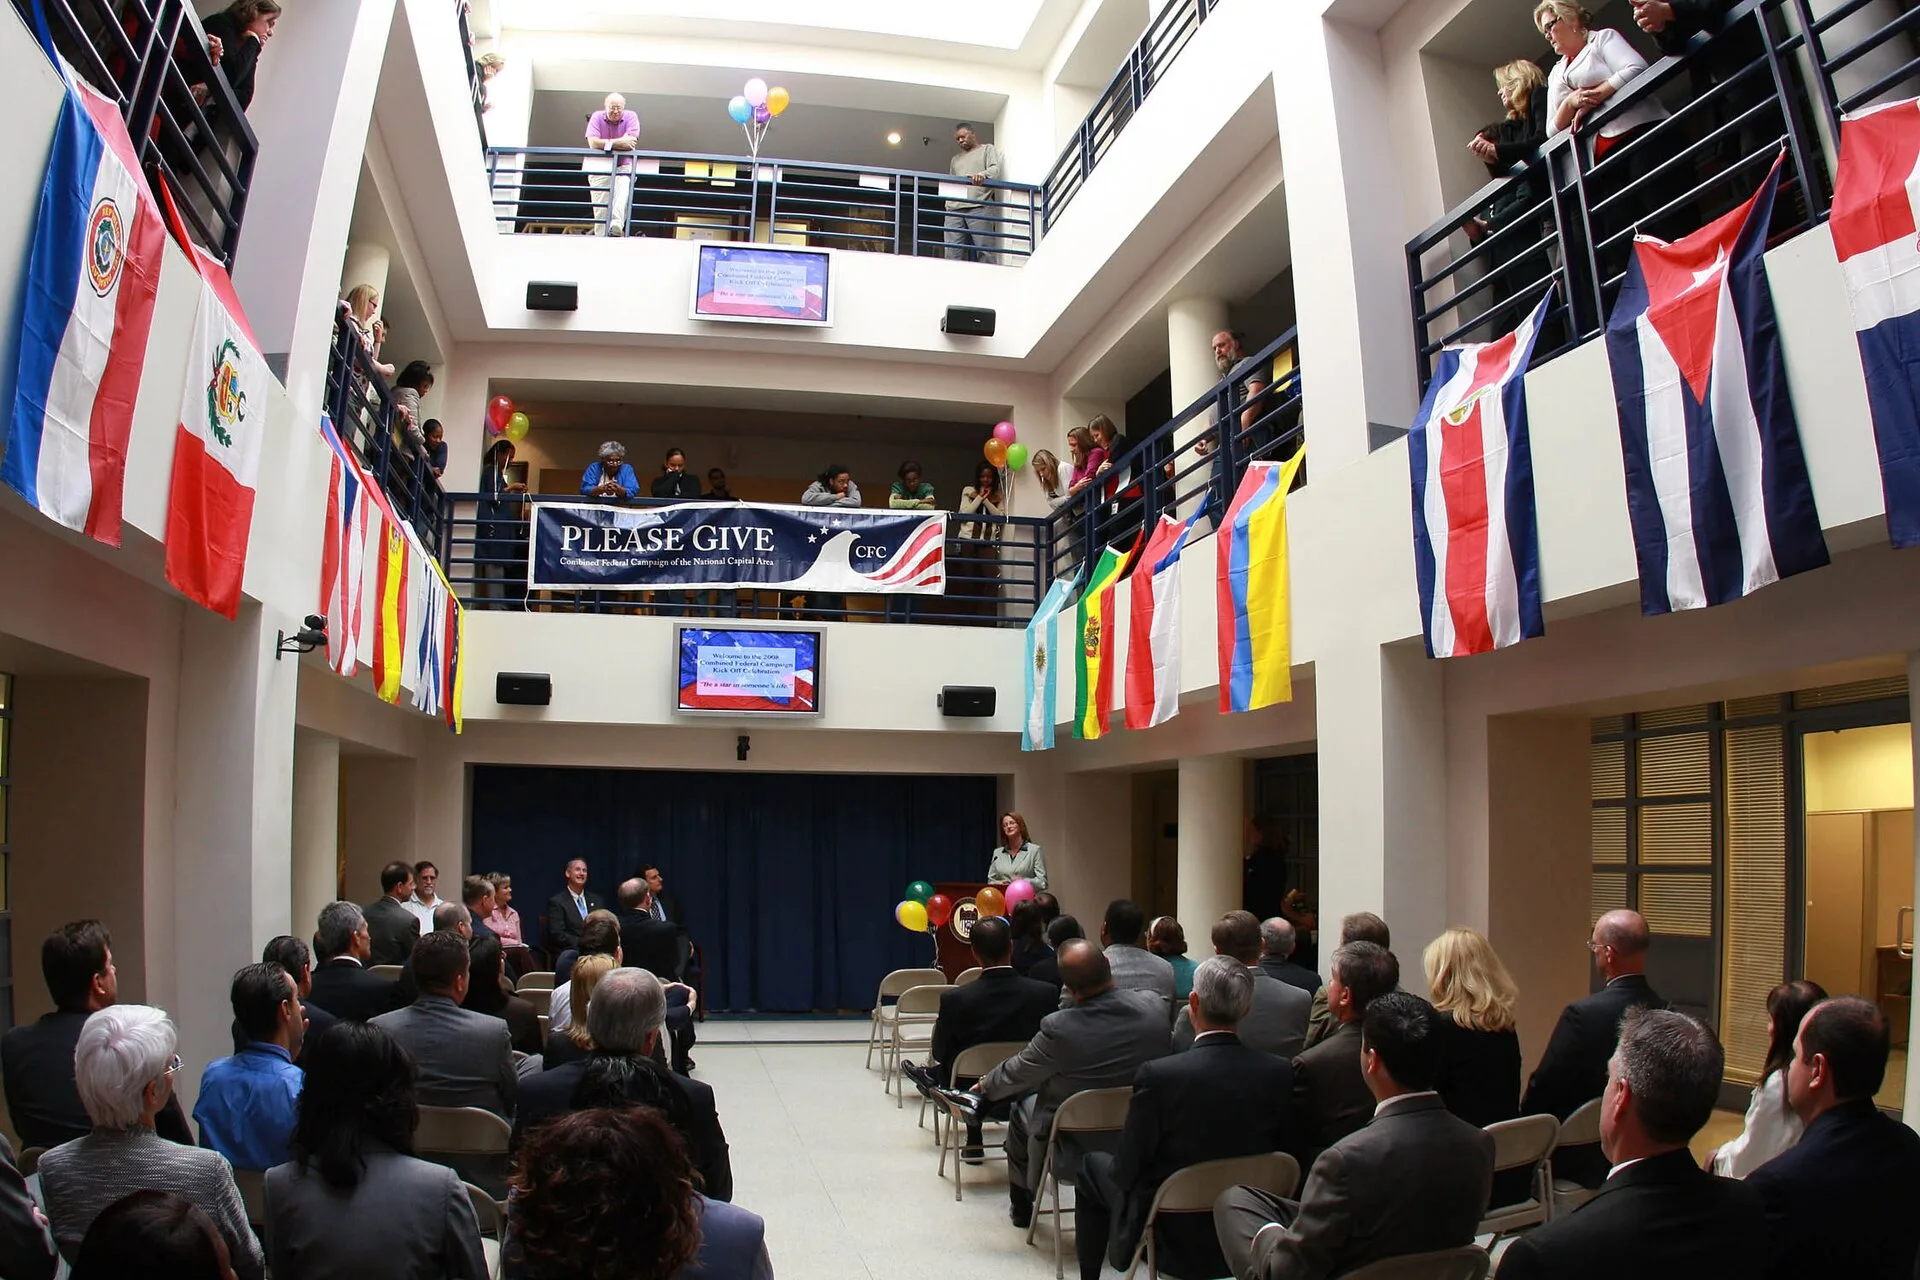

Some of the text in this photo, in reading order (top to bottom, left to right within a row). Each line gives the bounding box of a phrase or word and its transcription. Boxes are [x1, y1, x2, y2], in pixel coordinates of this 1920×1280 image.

[560, 524, 775, 552] PLEASE GIVE
[855, 545, 887, 559] CFC
[560, 556, 774, 568] Combined Federal Campaign of the National Capital Area
